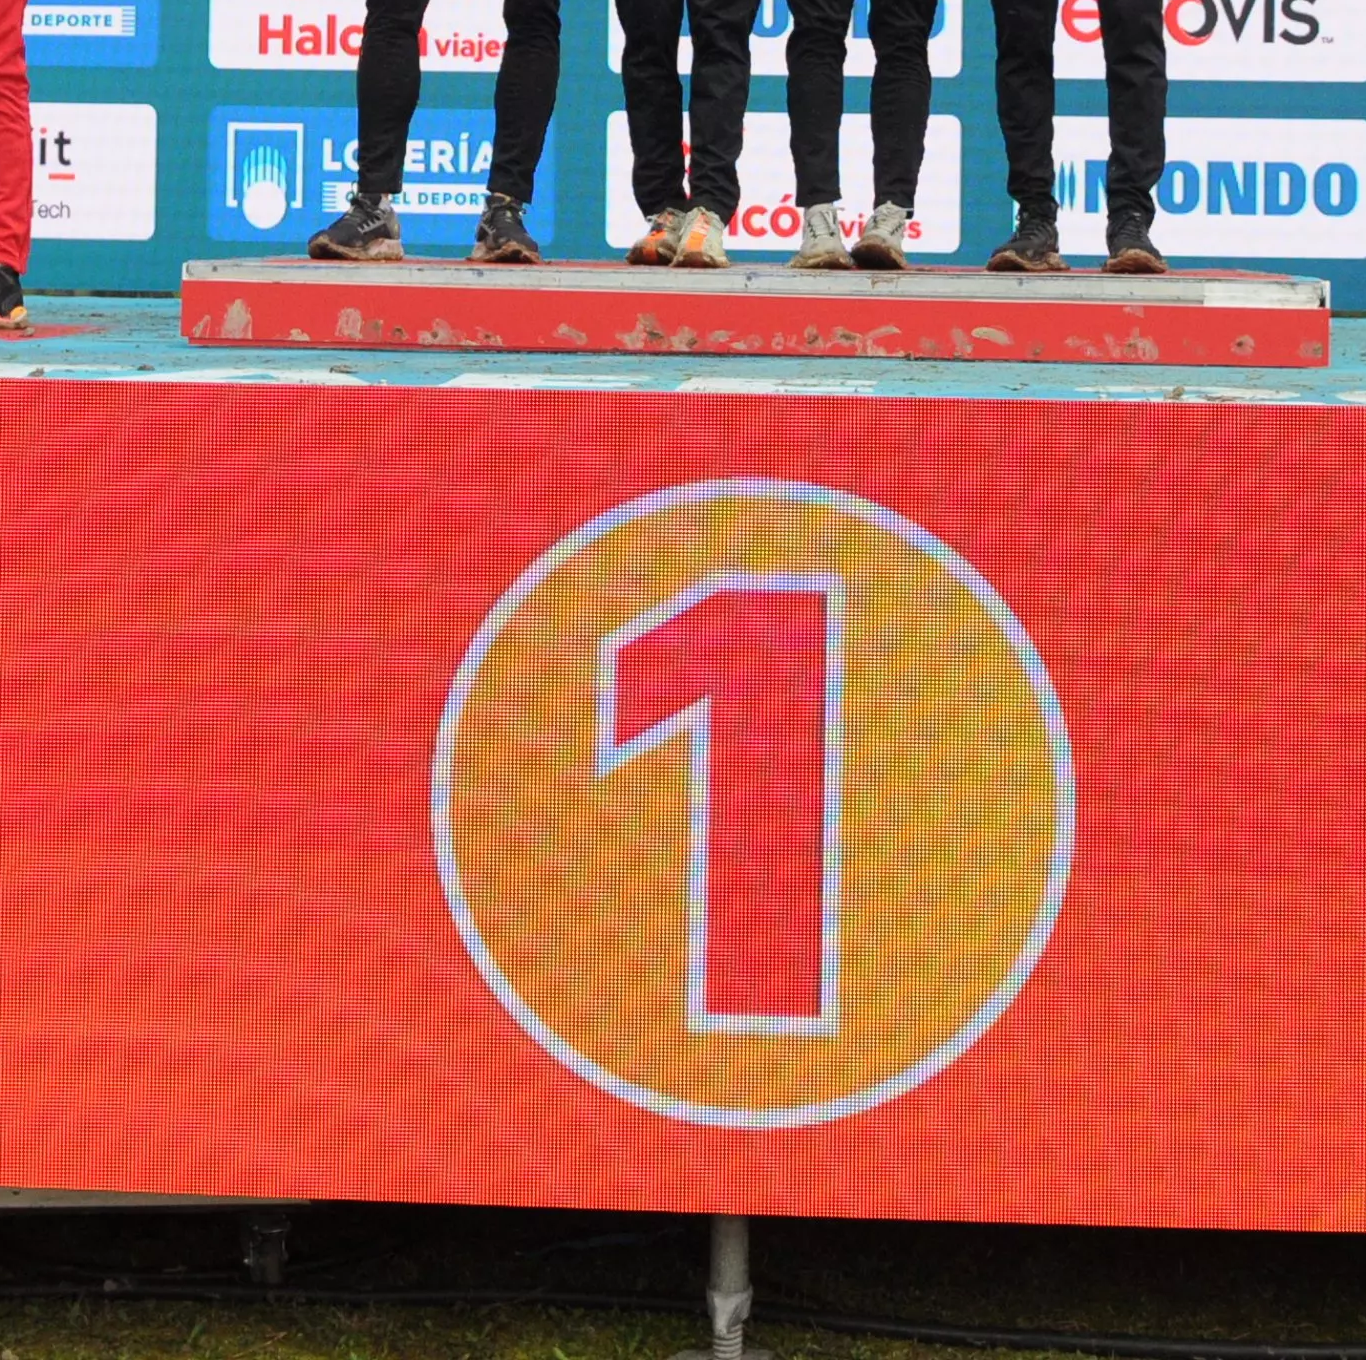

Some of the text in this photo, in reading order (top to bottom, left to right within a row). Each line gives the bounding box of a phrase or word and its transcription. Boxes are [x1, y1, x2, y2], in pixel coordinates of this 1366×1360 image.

[31, 13, 113, 28] DEPORTE
[435, 32, 507, 62] viaje
[322, 132, 494, 174] LOERÍA
[418, 192, 489, 207] DEPORT
[593, 570, 847, 1036] 1
